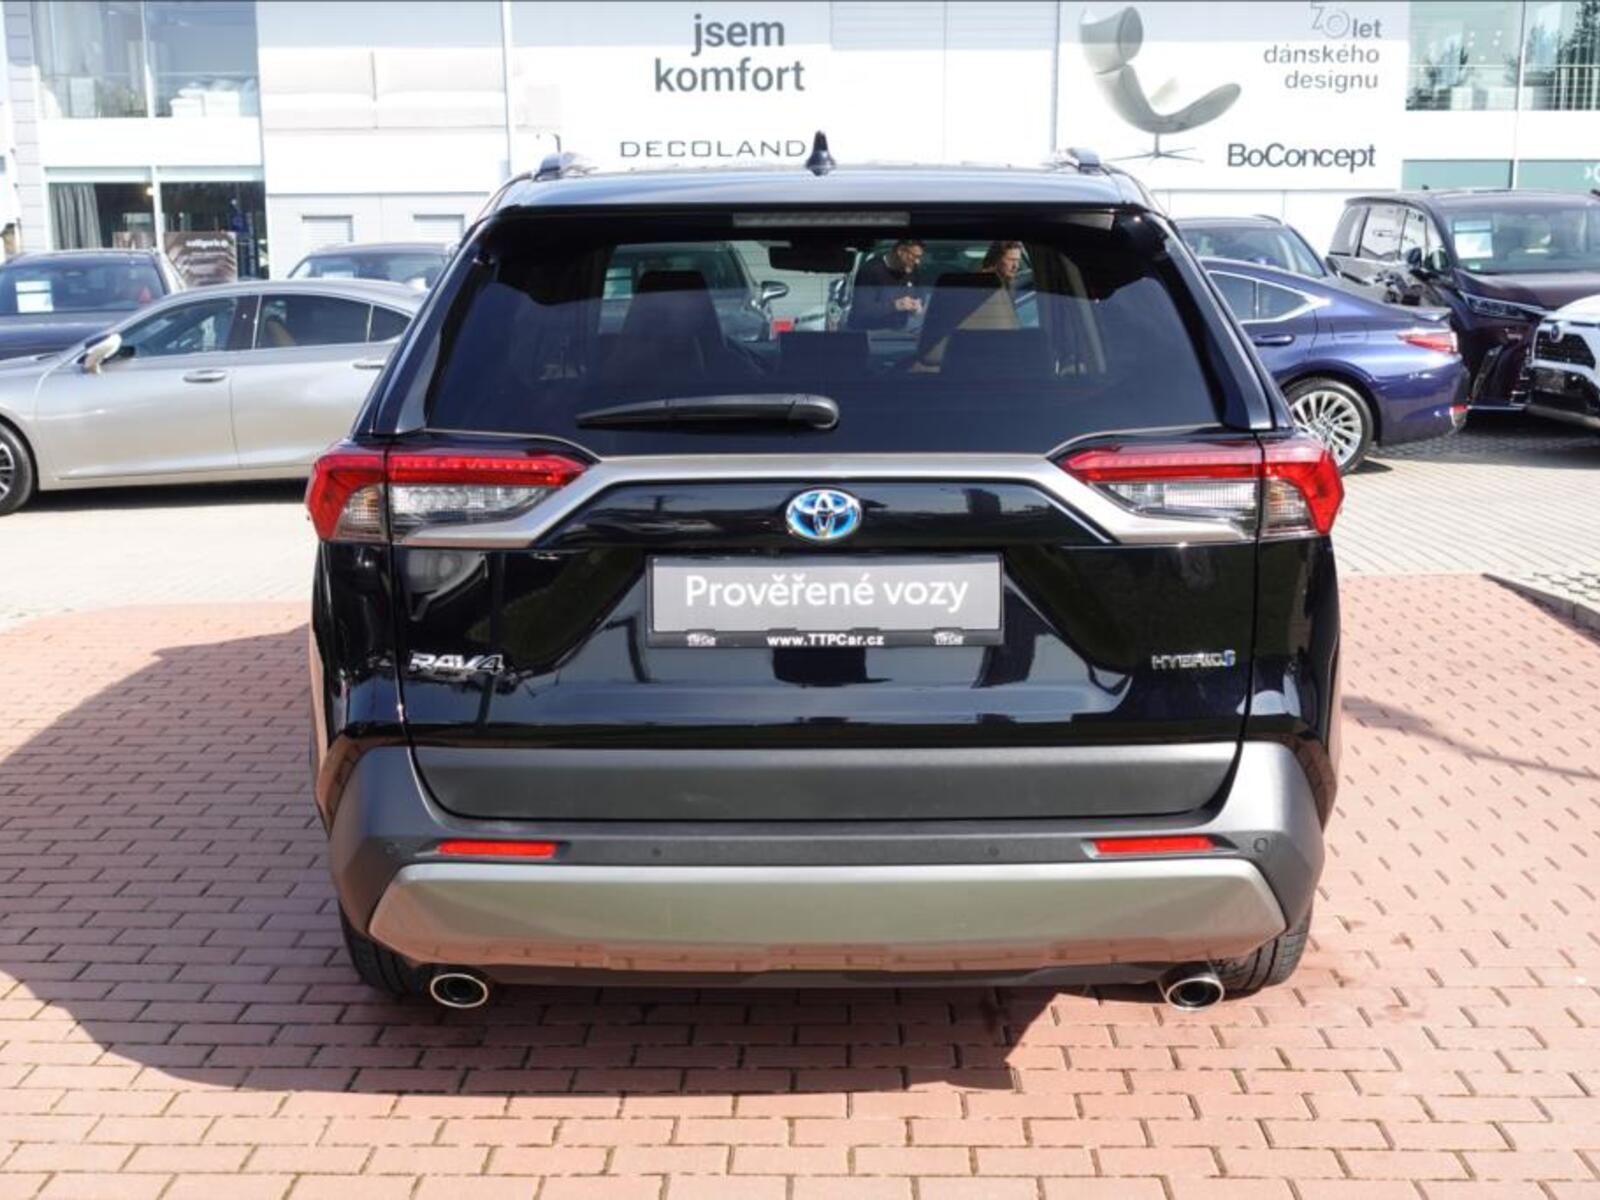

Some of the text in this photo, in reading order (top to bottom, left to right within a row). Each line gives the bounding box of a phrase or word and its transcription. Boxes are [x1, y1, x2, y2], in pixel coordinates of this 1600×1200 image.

[691, 13, 785, 57] jsem
[1263, 43, 1380, 64] dánského
[655, 57, 805, 92] komfort
[1284, 70, 1379, 94] designu
[620, 140, 806, 158] DECOLAND
[1227, 142, 1376, 173] BoConcept
[685, 573, 968, 613] Prověřené vozy
[767, 633, 884, 646] www.TTPCar.cz
[409, 653, 504, 674] RAV4
